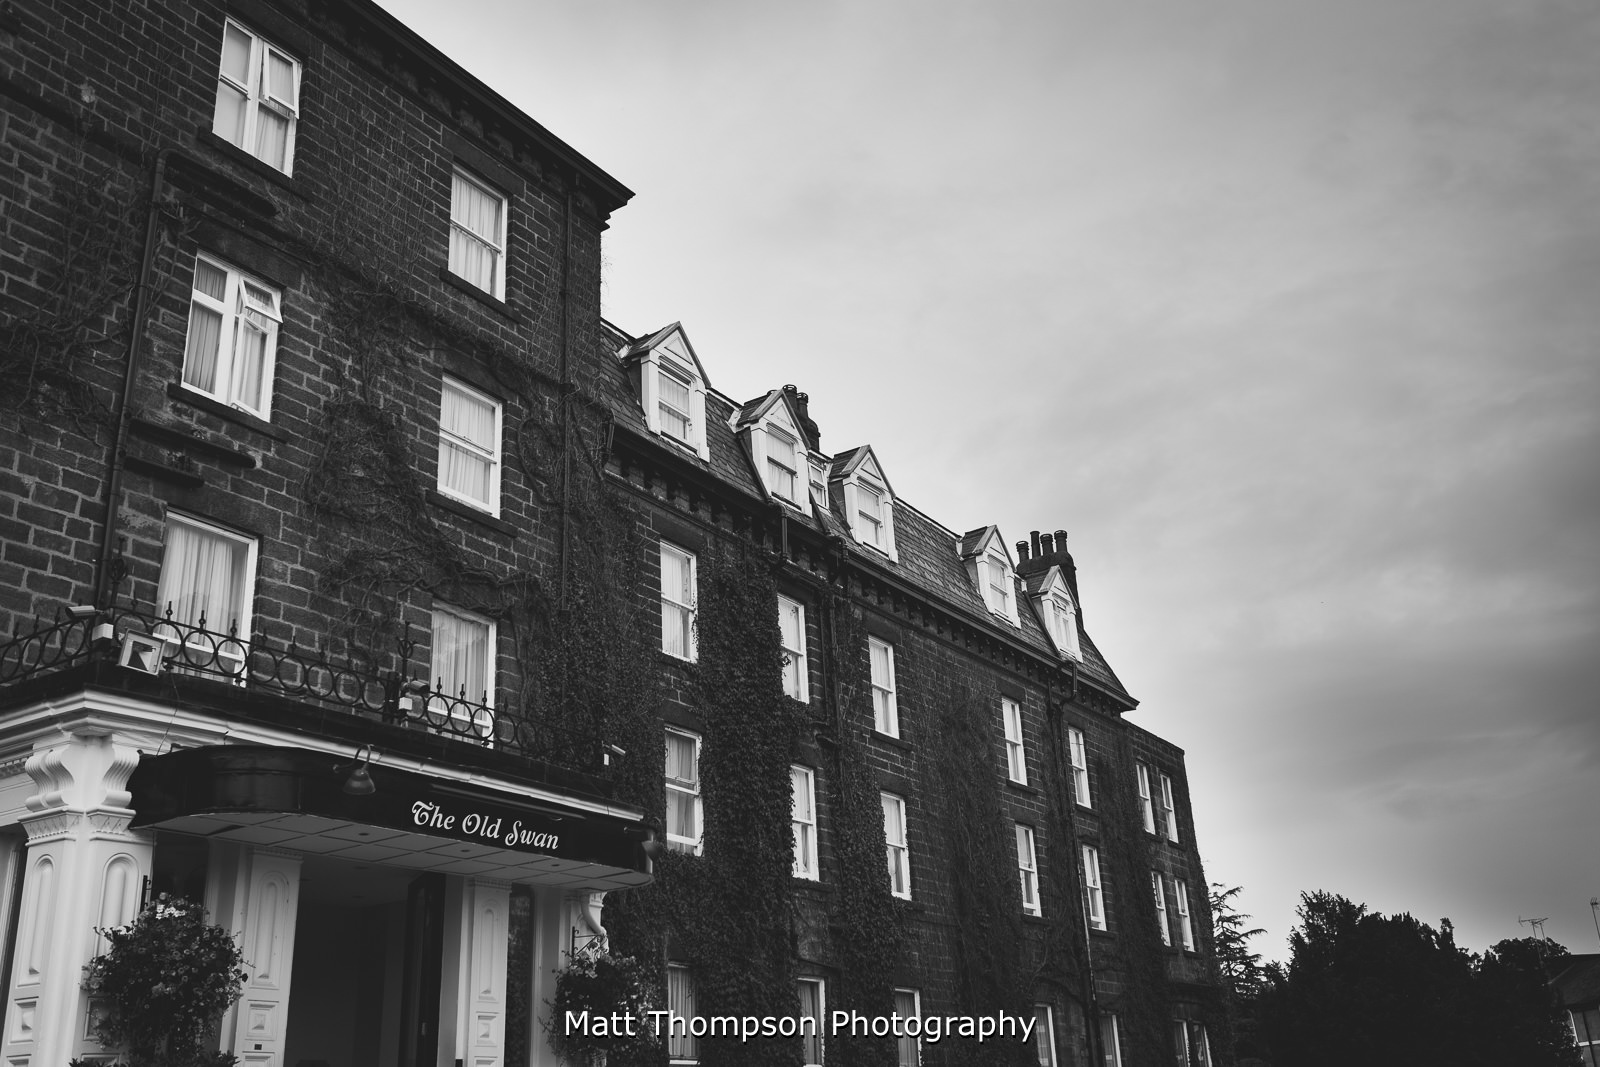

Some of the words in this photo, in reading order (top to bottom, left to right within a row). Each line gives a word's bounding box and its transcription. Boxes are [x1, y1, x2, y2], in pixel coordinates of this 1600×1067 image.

[412, 800, 456, 830] The
[462, 813, 502, 839] Old
[505, 820, 559, 850] Swan
